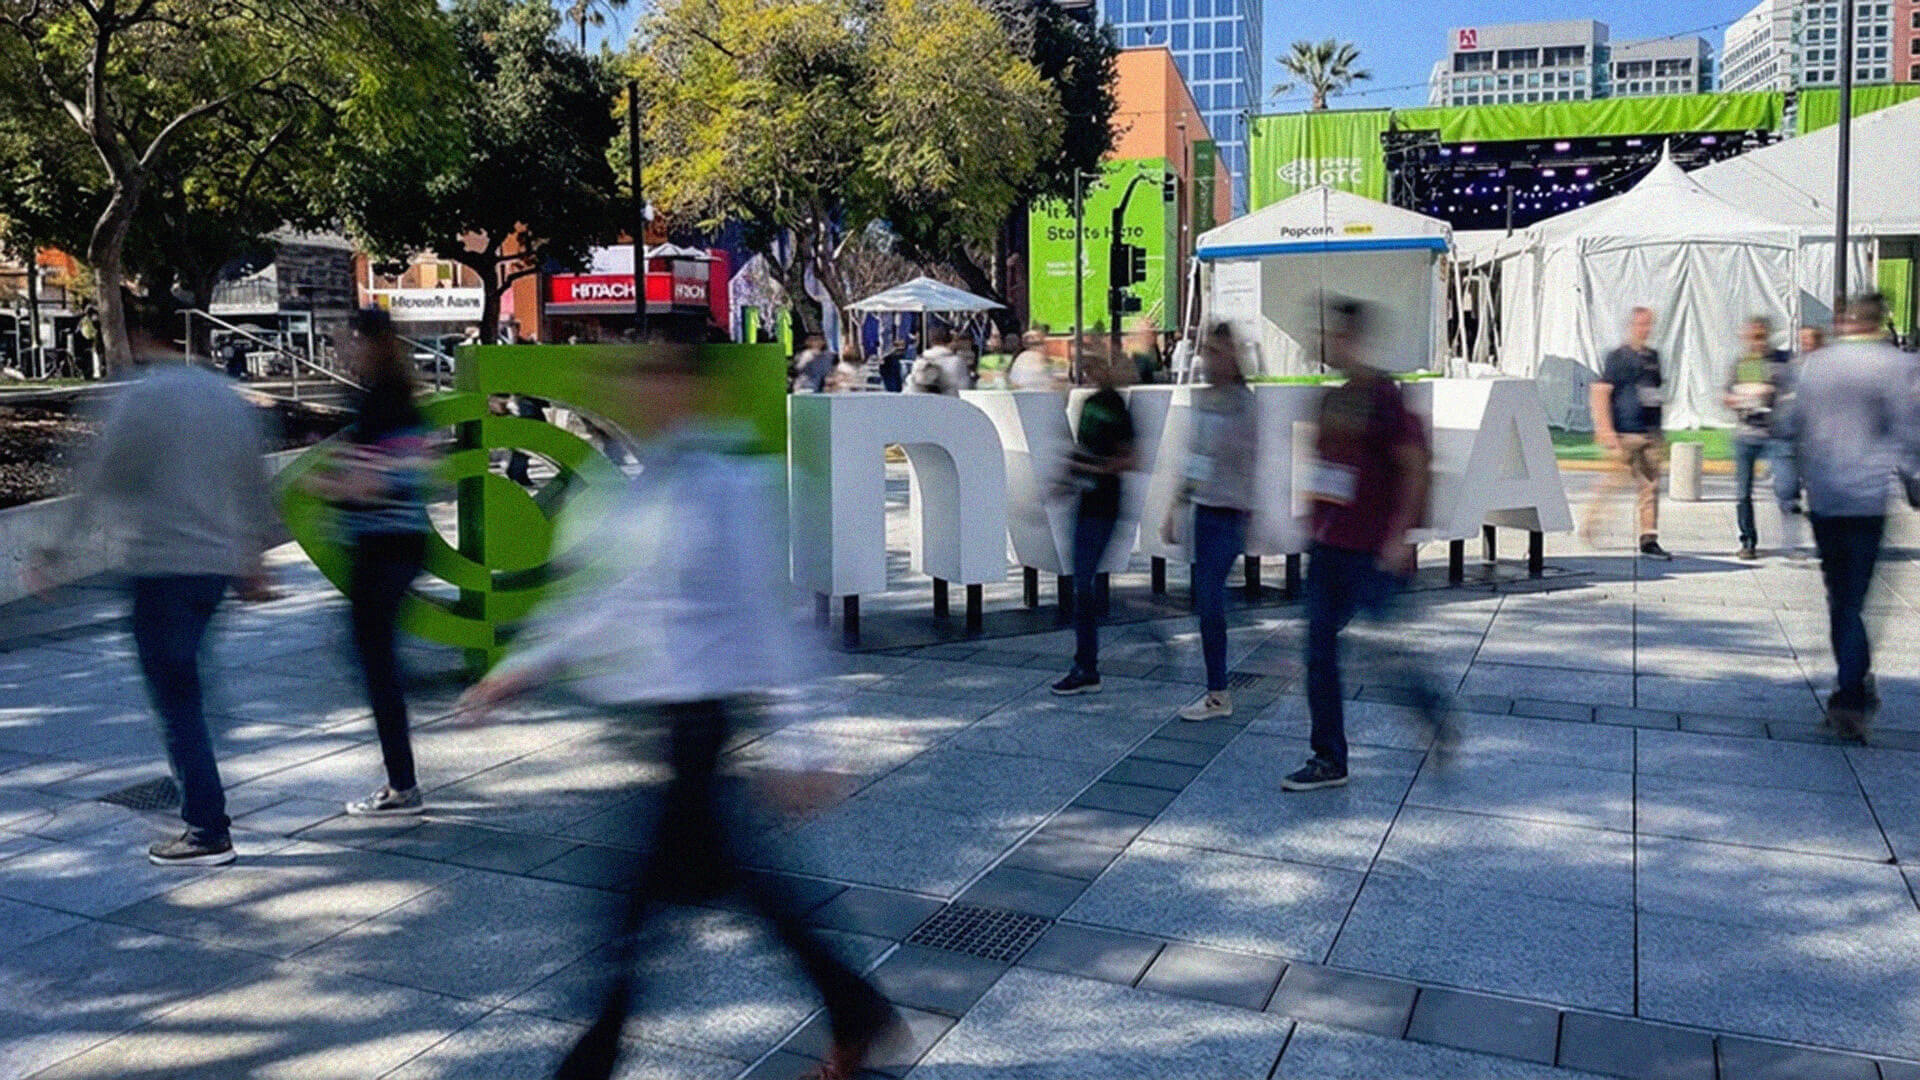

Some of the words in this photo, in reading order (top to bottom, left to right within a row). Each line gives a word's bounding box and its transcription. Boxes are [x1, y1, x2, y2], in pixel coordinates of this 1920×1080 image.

[1047, 225, 1100, 241] Stats
[1280, 226, 1334, 238] Popcorn
[571, 282, 637, 299] HITACH
